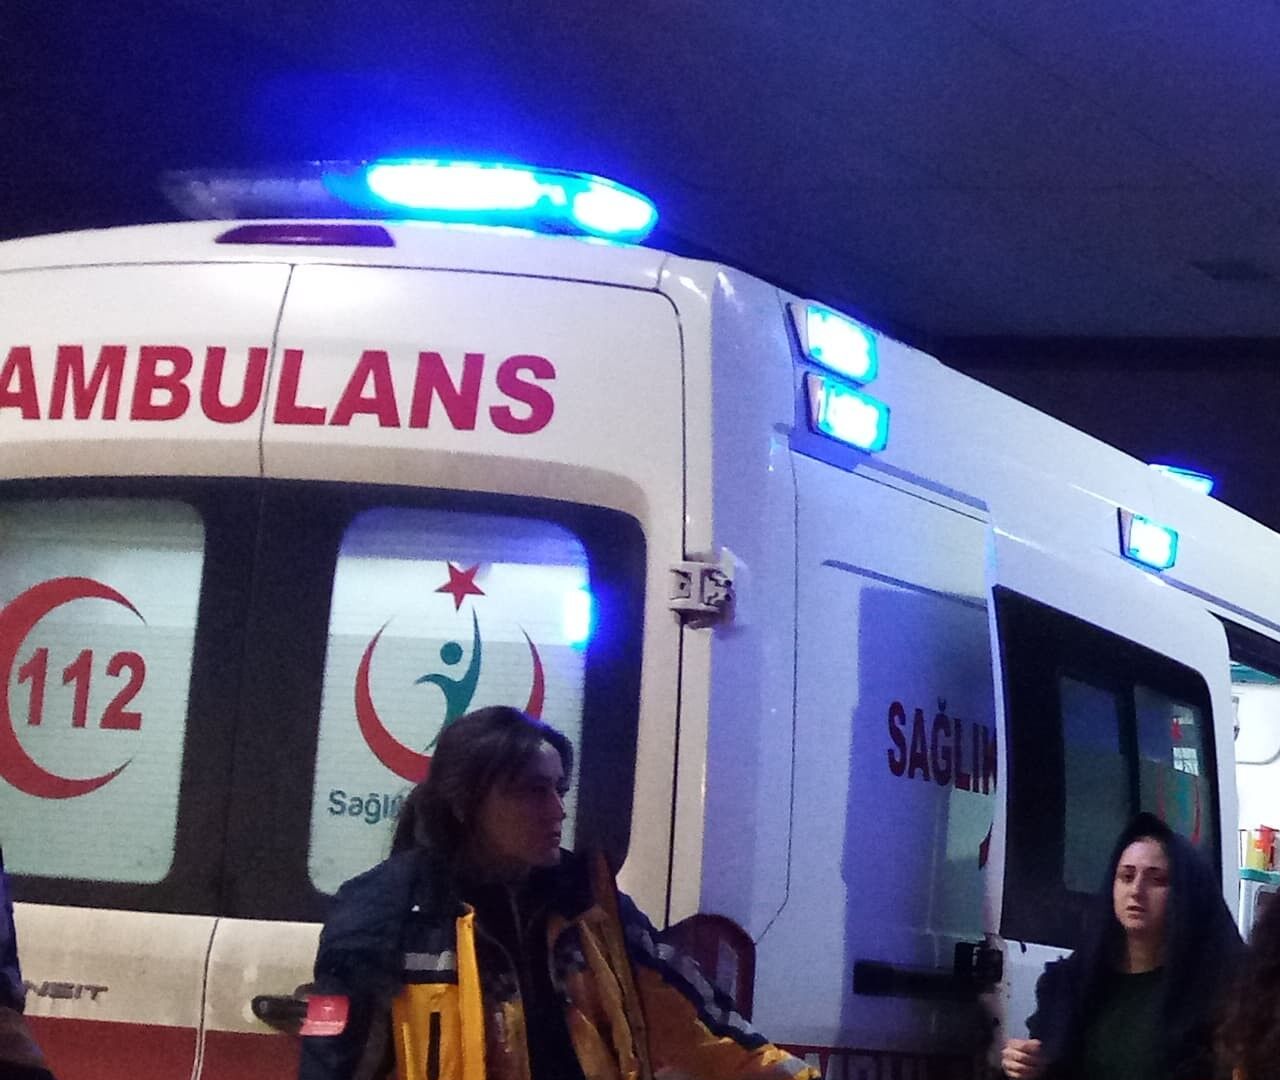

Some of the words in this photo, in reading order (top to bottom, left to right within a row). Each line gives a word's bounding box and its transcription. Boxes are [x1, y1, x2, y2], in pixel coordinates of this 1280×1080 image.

[0, 345, 557, 434] AMBULANS
[18, 647, 146, 730] 112
[327, 789, 399, 824] Sağlı
